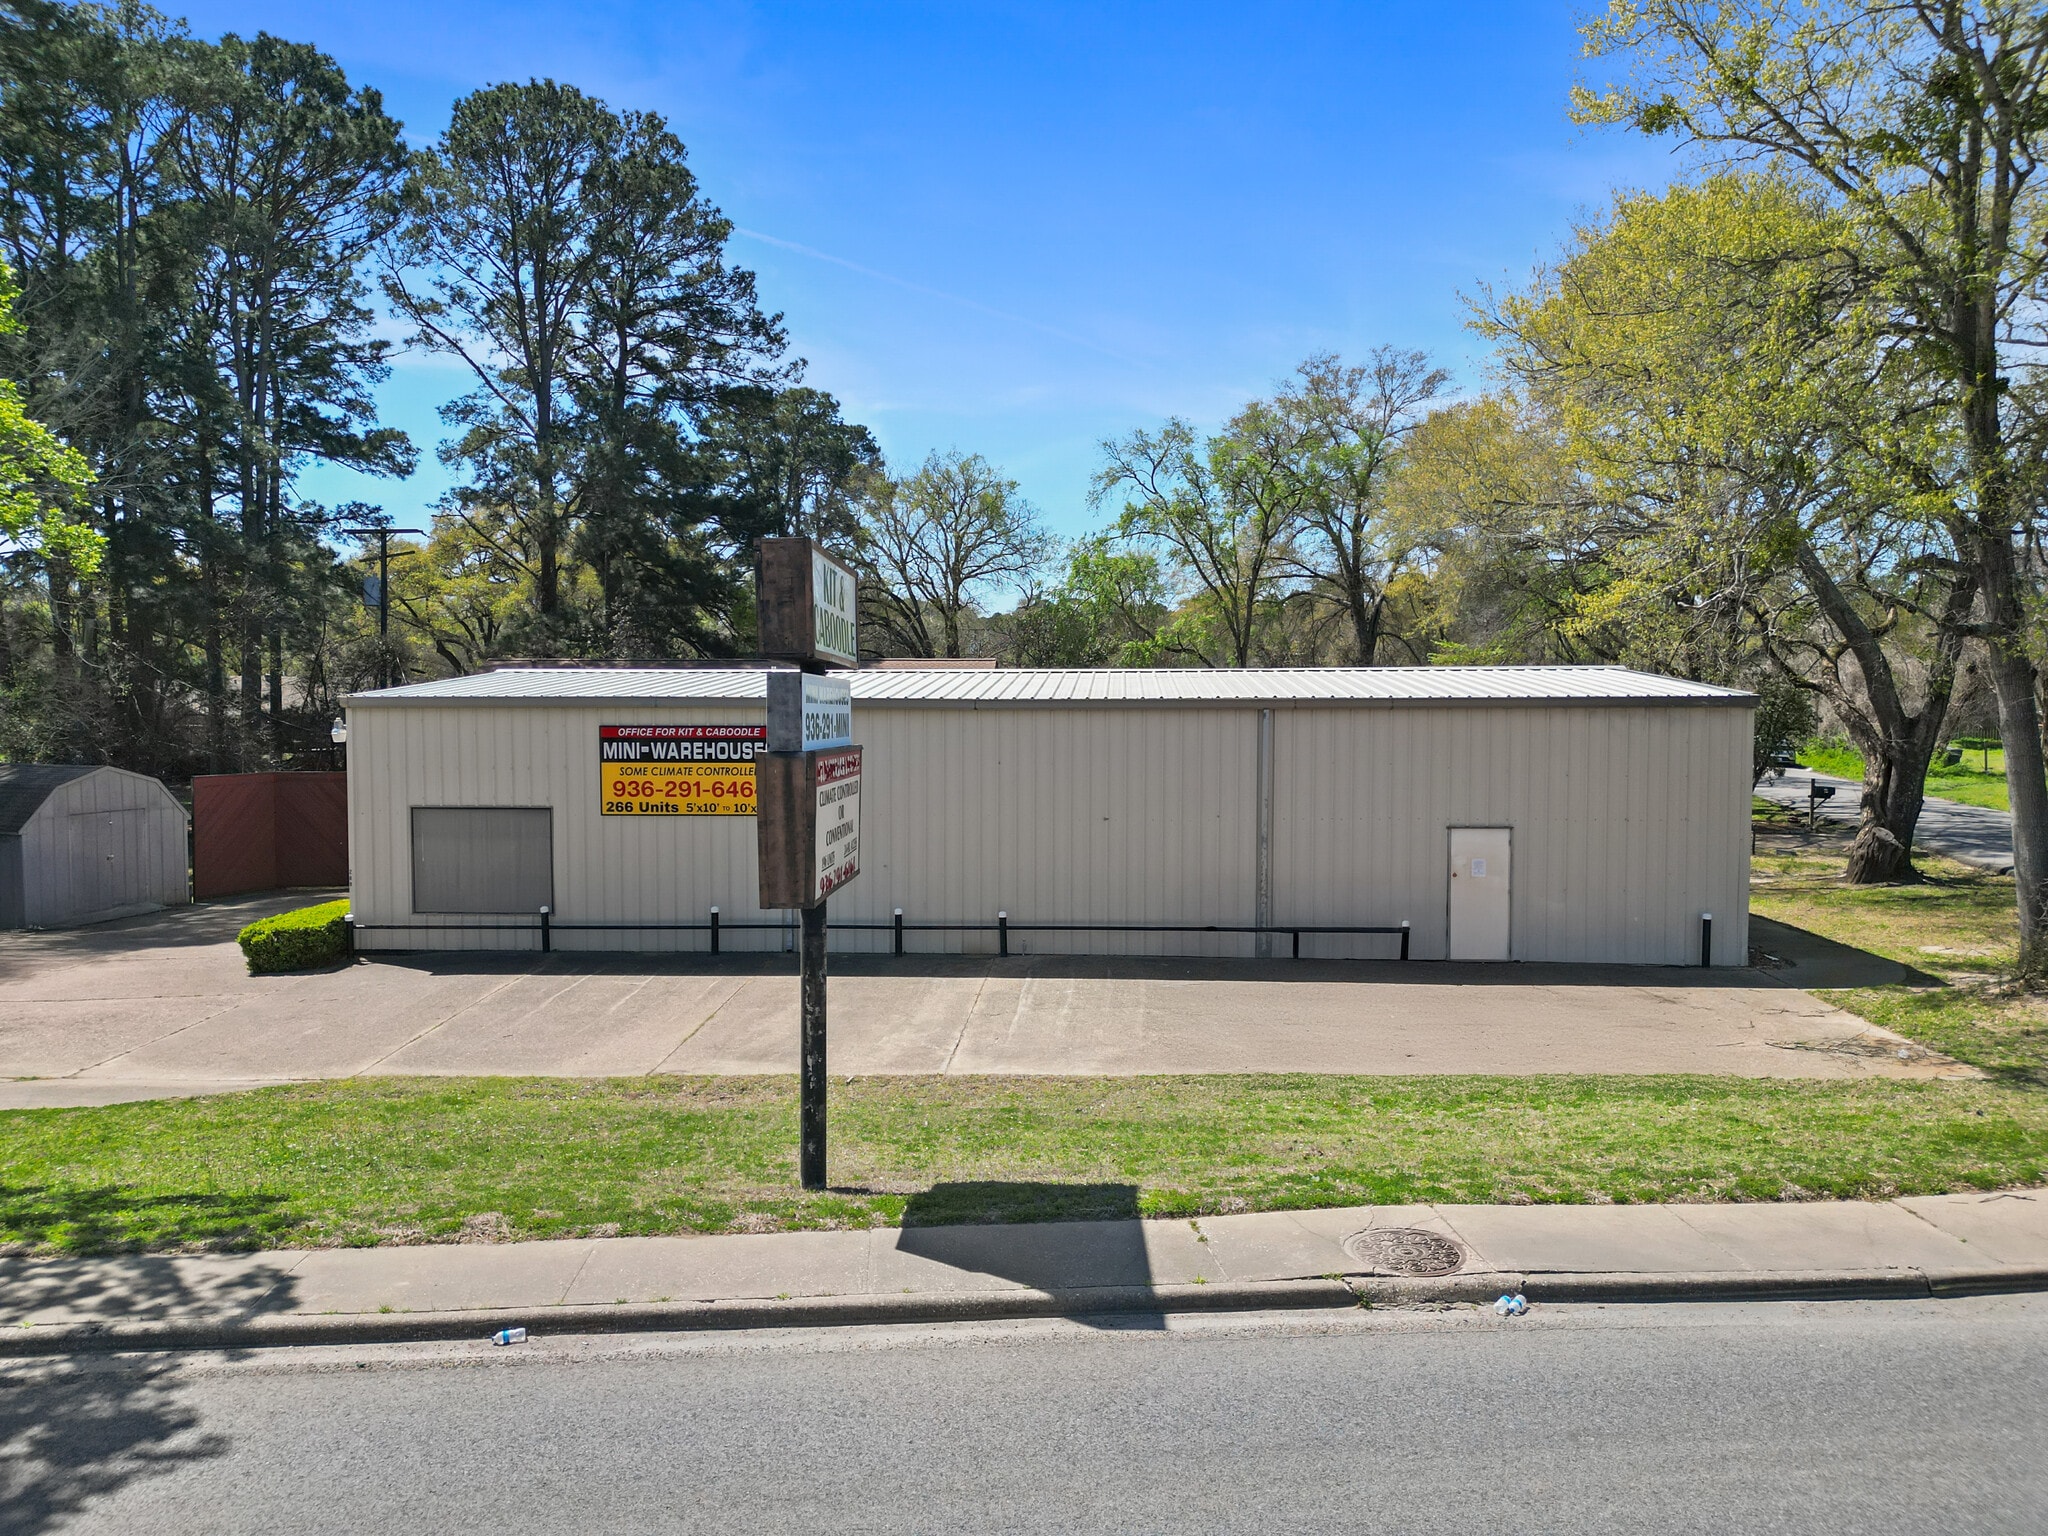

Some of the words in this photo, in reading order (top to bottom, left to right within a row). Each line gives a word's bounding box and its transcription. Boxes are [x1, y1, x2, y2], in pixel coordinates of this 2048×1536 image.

[824, 564, 837, 607] KIT
[839, 575, 845, 612] &
[814, 604, 856, 657] CABOODLE
[618, 727, 653, 736] OFFICE
[655, 727, 675, 736] FOR
[678, 727, 694, 736] KIT
[696, 727, 703, 736] &
[705, 727, 761, 736] CABOODLE
[806, 712, 850, 741] 936-291-MINI
[603, 741, 767, 760] MINI-WAREHOUSE
[619, 766, 648, 776] SOME
[651, 766, 693, 776] CLIMATE
[695, 766, 757, 776] CONTROLLE
[612, 780, 757, 798] 936-291-646
[820, 787, 836, 807] CLIMATE
[837, 780, 858, 800] CONTROLLED
[606, 801, 634, 813] 266
[639, 801, 679, 813] Units
[686, 802, 719, 813] 5'x10'
[838, 804, 844, 820] OR
[826, 819, 853, 846] CONVENTIONAL
